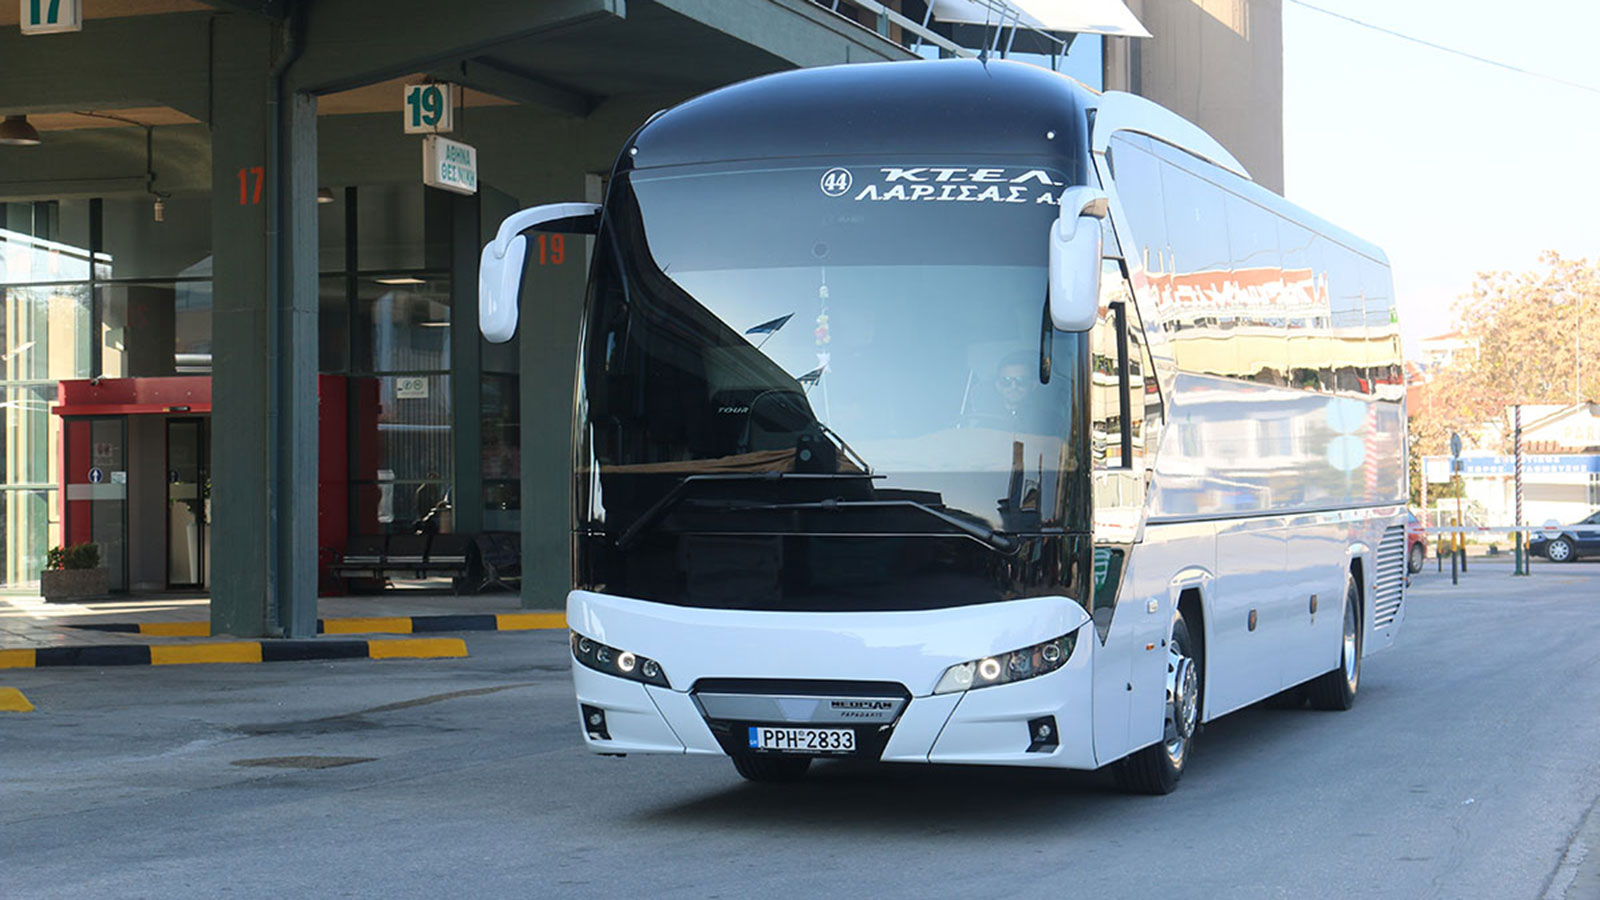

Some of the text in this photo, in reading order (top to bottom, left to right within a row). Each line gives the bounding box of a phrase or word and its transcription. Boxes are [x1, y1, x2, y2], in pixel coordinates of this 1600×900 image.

[407, 86, 444, 127] 19
[236, 166, 264, 206] 17
[825, 172, 848, 191] 44
[537, 232, 565, 266] 19
[1564, 425, 1600, 441] PAR
[831, 701, 892, 710] NEOPLAN
